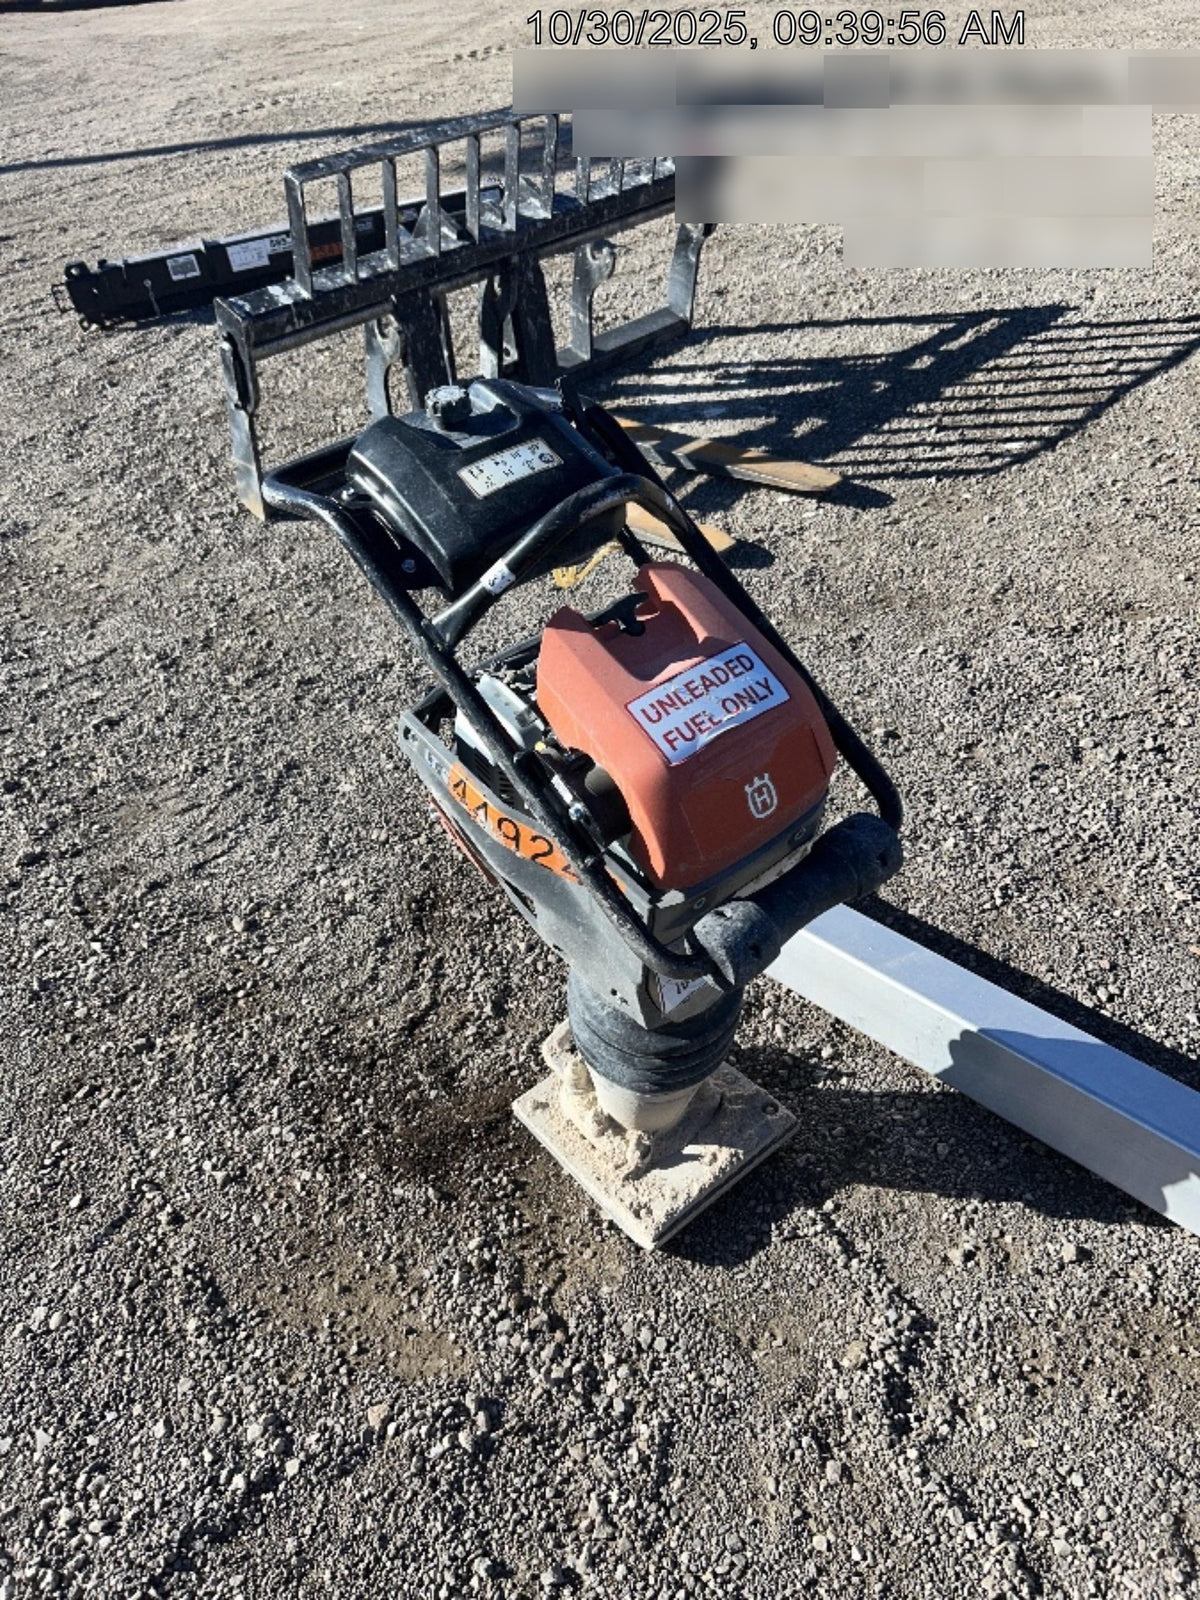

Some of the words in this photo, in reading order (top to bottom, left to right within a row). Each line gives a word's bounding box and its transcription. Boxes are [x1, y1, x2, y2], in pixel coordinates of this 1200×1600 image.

[640, 653, 755, 724] UNLEADED
[662, 710, 722, 752] FUEL
[721, 677, 775, 715] ONLY
